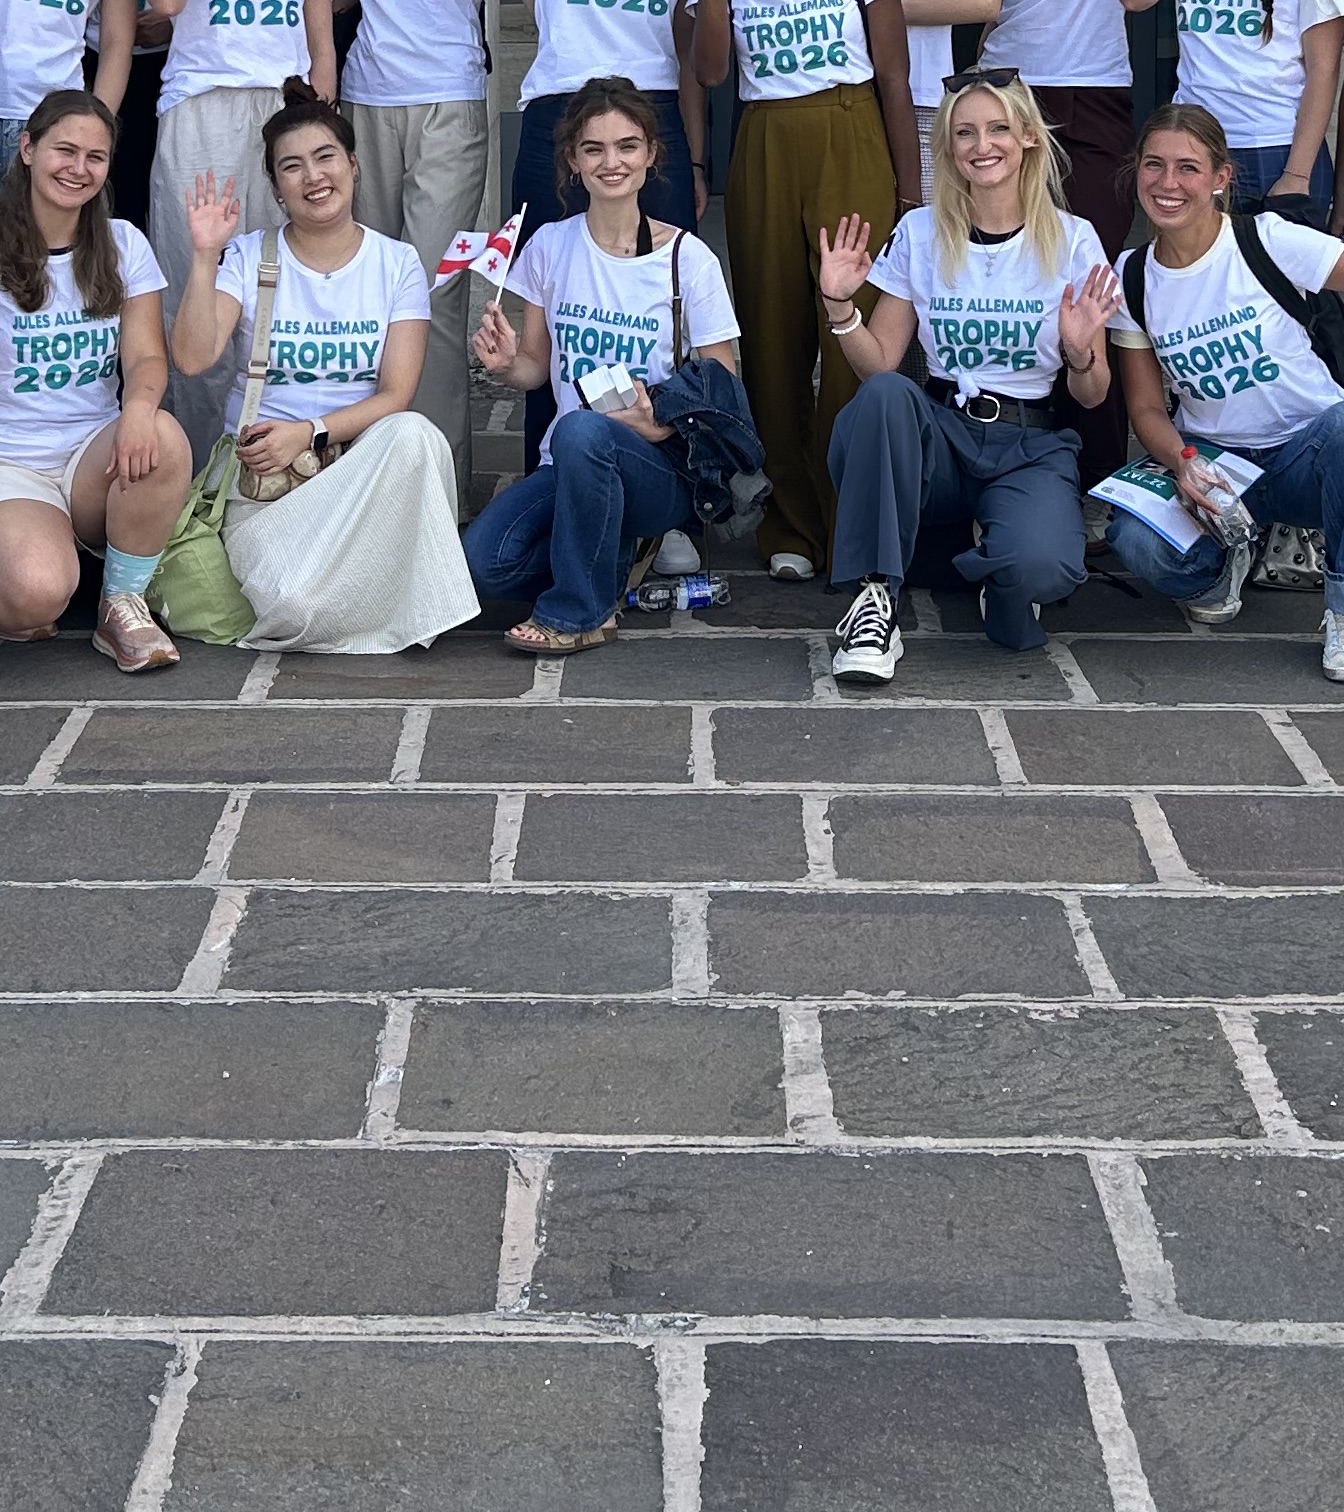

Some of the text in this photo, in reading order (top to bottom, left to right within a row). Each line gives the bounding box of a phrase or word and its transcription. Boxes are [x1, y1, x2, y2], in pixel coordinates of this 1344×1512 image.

[209, 0, 299, 27] 2026
[742, 6, 775, 21] JULES
[742, 12, 845, 52] TROPHY
[750, 41, 849, 78] 2026
[588, 307, 659, 332] ALLEMAND
[966, 298, 1044, 314] ALLEMAND
[12, 313, 50, 330] JULES
[304, 319, 379, 336] ALLEMAND
[929, 318, 1043, 349] TROPHY
[1187, 305, 1257, 341] ALLEMAND
[555, 322, 657, 365] TROPHY
[1160, 324, 1262, 381] TROPHY
